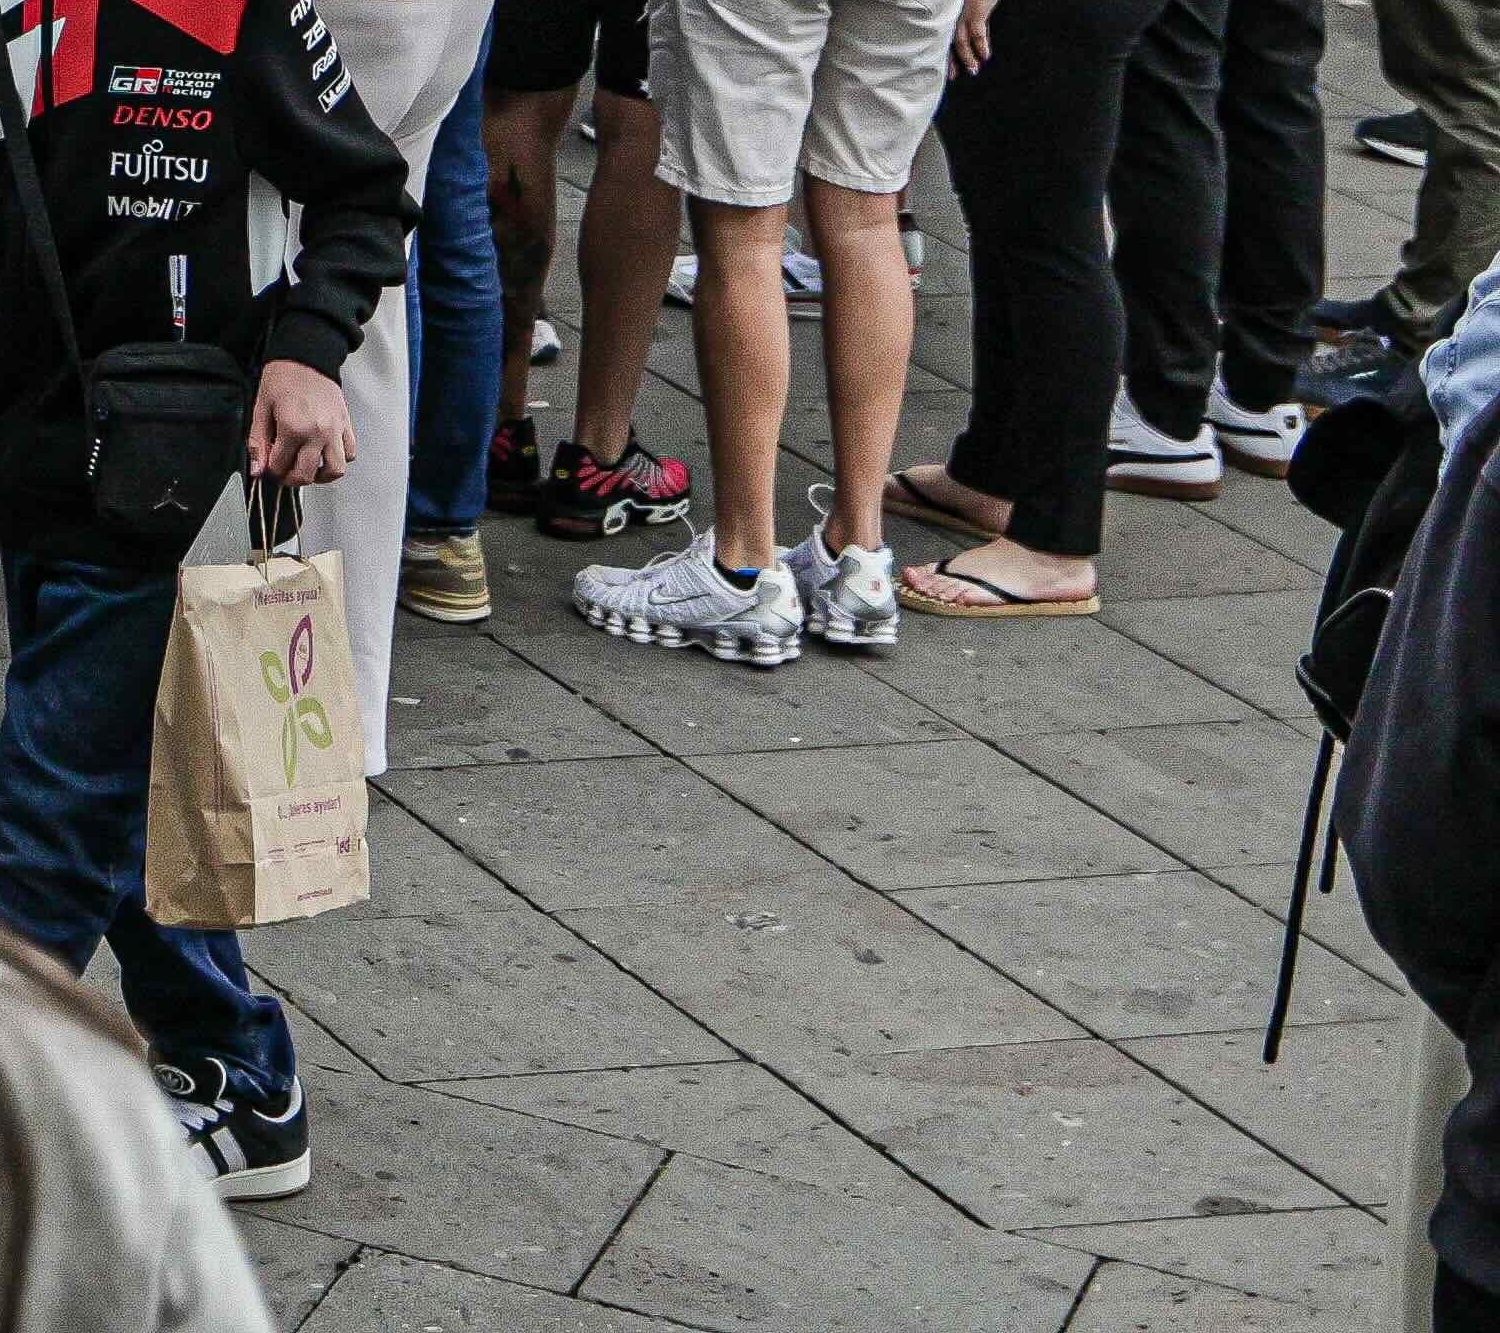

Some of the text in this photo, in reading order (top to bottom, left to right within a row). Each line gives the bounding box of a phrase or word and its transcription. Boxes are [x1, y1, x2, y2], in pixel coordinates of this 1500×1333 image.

[164, 68, 222, 81] TOYOTA
[111, 77, 158, 94] GR
[162, 78, 215, 89] GAZOO
[161, 85, 212, 100] Racing
[111, 105, 214, 132] DENSO
[109, 139, 209, 186] FUJITSU
[107, 195, 175, 221] Mobil
